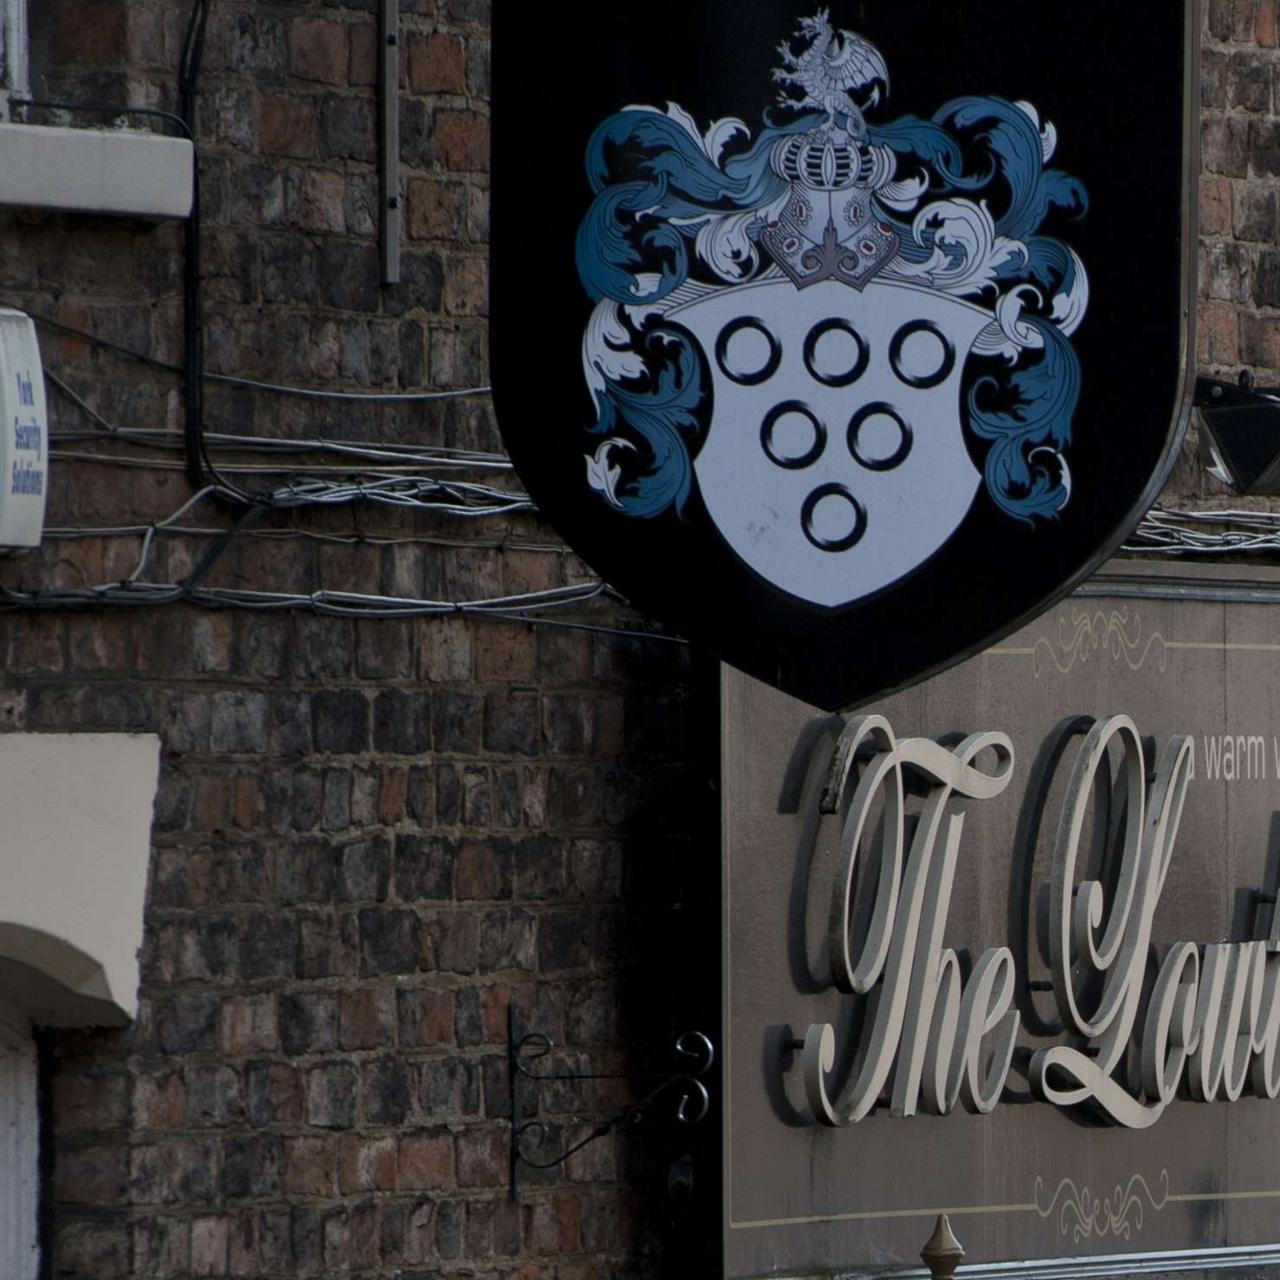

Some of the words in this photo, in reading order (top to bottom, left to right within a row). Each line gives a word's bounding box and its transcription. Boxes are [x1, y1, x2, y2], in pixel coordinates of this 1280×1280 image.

[17, 371, 35, 406] York
[14, 416, 41, 462] Security
[12, 459, 43, 495] Solutions
[1204, 735, 1266, 780] warm
[804, 714, 1020, 1127] The
